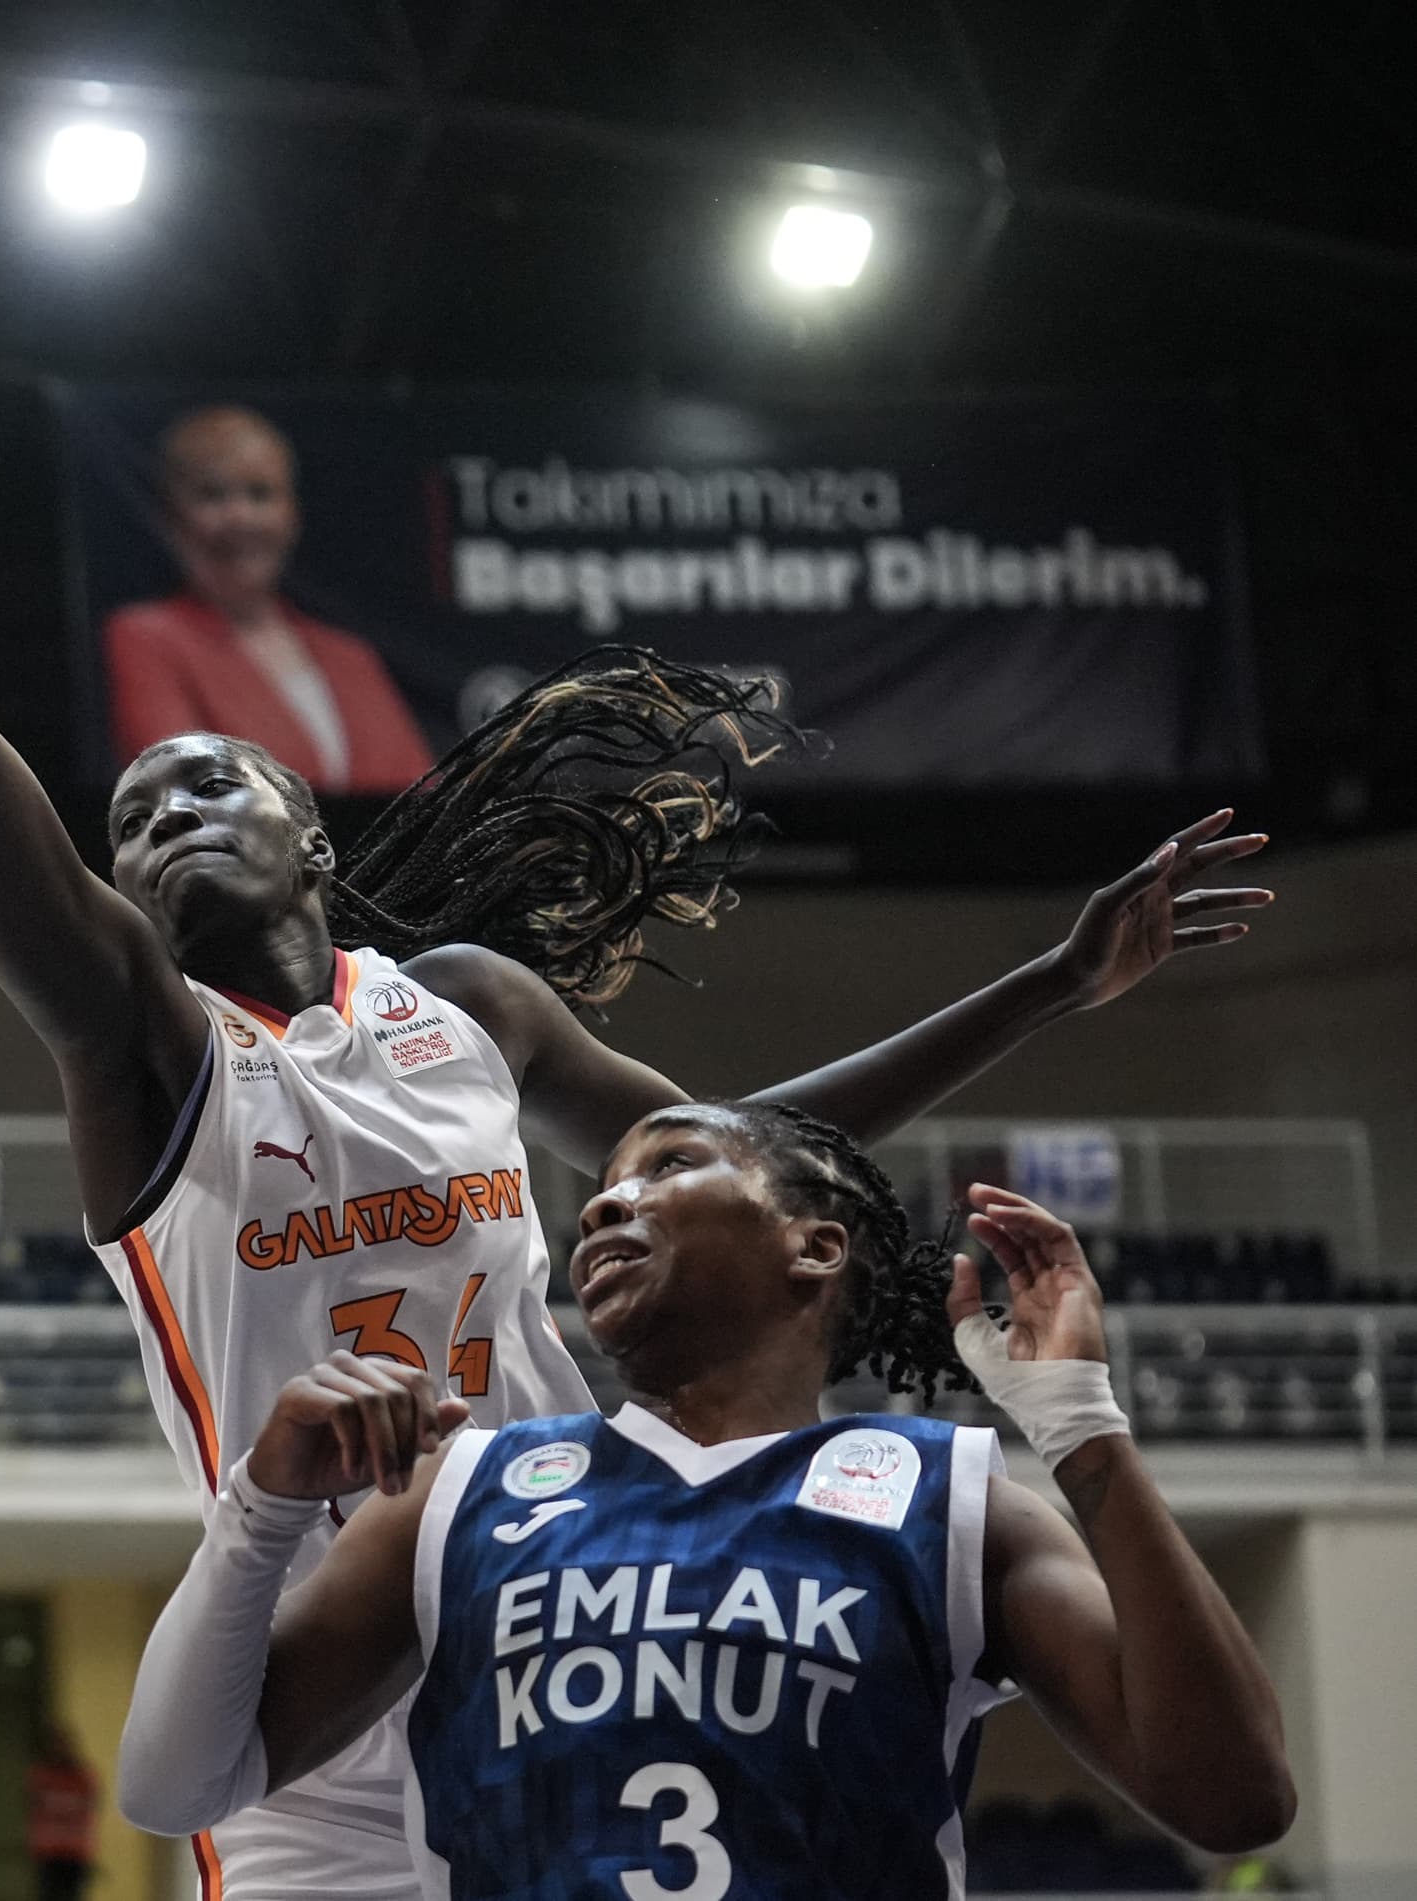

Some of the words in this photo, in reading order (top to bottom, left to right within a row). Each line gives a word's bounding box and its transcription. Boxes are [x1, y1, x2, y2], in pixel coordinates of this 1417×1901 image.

[230, 1059, 279, 1073] ÇAĞDAŞ
[387, 1016, 445, 1039] HALKBANK
[390, 1031, 444, 1052] KADINLAR
[236, 1168, 524, 1271] GALATASARAY
[493, 1563, 869, 1664] EMLAK
[495, 1640, 858, 1749] KONUT
[618, 1761, 732, 1901] 3
